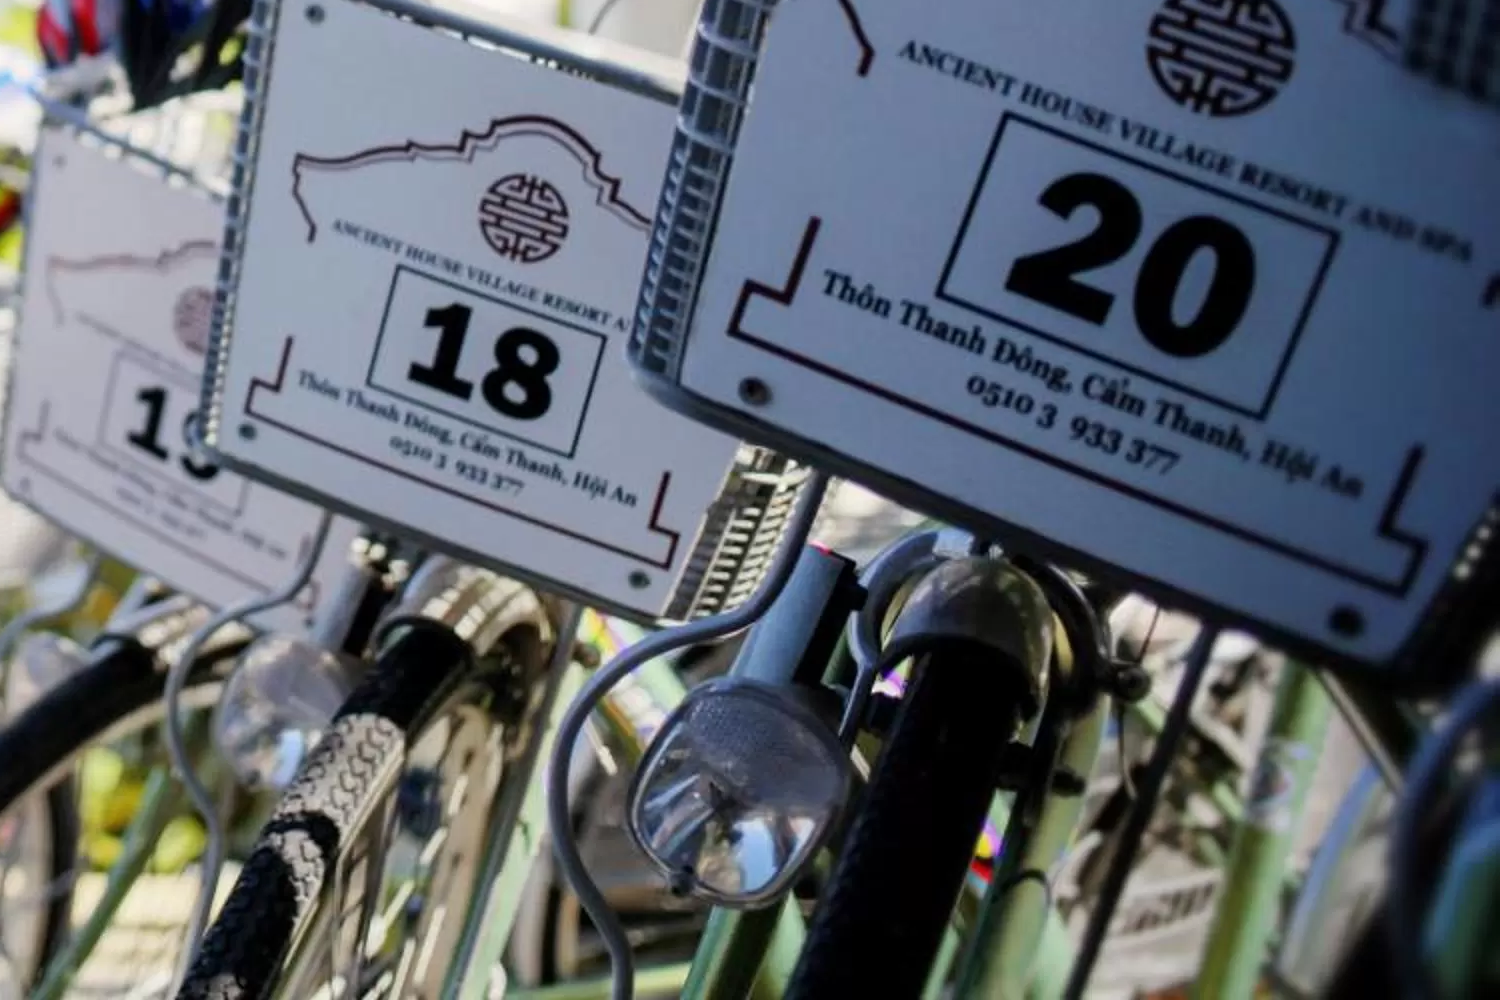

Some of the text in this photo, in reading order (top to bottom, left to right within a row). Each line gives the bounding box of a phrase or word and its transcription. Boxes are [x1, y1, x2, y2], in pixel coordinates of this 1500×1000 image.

[899, 39, 1018, 97] ANCIENT
[1018, 82, 1116, 135] HOUSE
[1120, 117, 1235, 178] VILLAGE
[1239, 161, 1348, 218] RESORT
[1354, 204, 1417, 241] AND
[332, 219, 403, 255] ANCIENT
[406, 245, 463, 278] HOUSE
[467, 266, 539, 302] VILLAGE
[542, 291, 612, 326] RESORT
[1005, 172, 1256, 359] 20
[407, 302, 560, 421] 18
[822, 269, 892, 319] Thôn
[899, 299, 986, 356] Thanh
[1154, 399, 1250, 462] Thanh,
[1321, 462, 1365, 499] An
[346, 388, 400, 424] Thanh
[611, 485, 639, 508] An
[966, 374, 1181, 475] 0510 3 933 377
